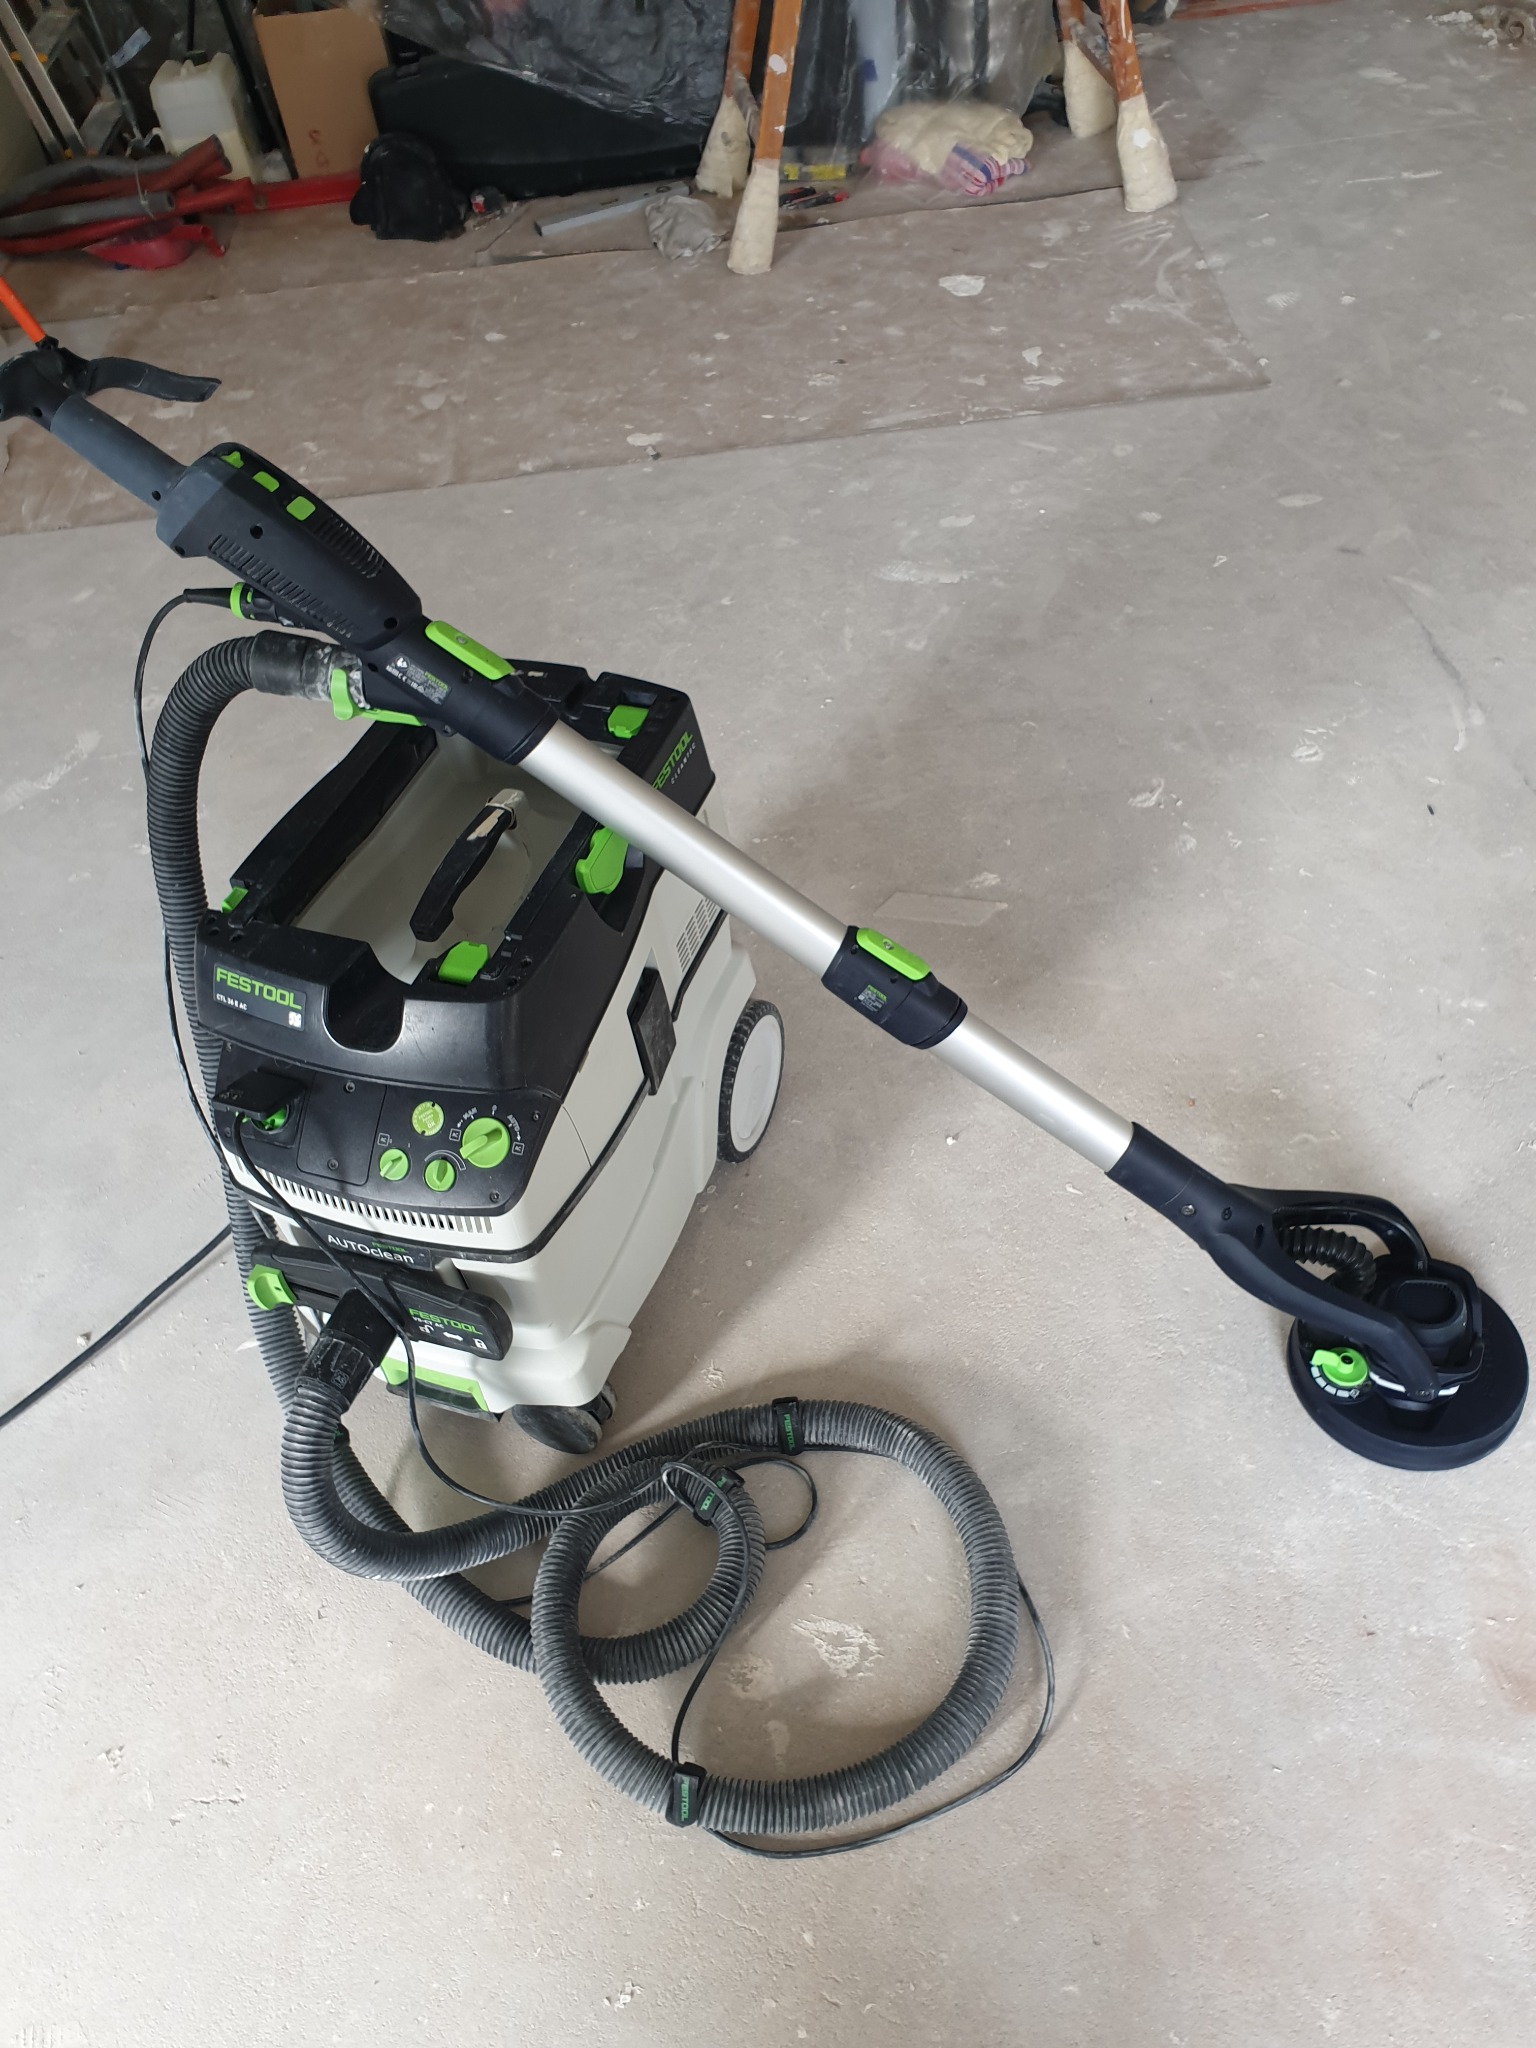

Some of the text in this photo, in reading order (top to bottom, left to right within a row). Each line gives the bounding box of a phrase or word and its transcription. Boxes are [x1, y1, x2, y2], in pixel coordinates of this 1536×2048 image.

[215, 966, 303, 1011] FESTOOL
[327, 1234, 415, 1264] AUTOclean
[408, 1307, 484, 1336] FESTOOL
